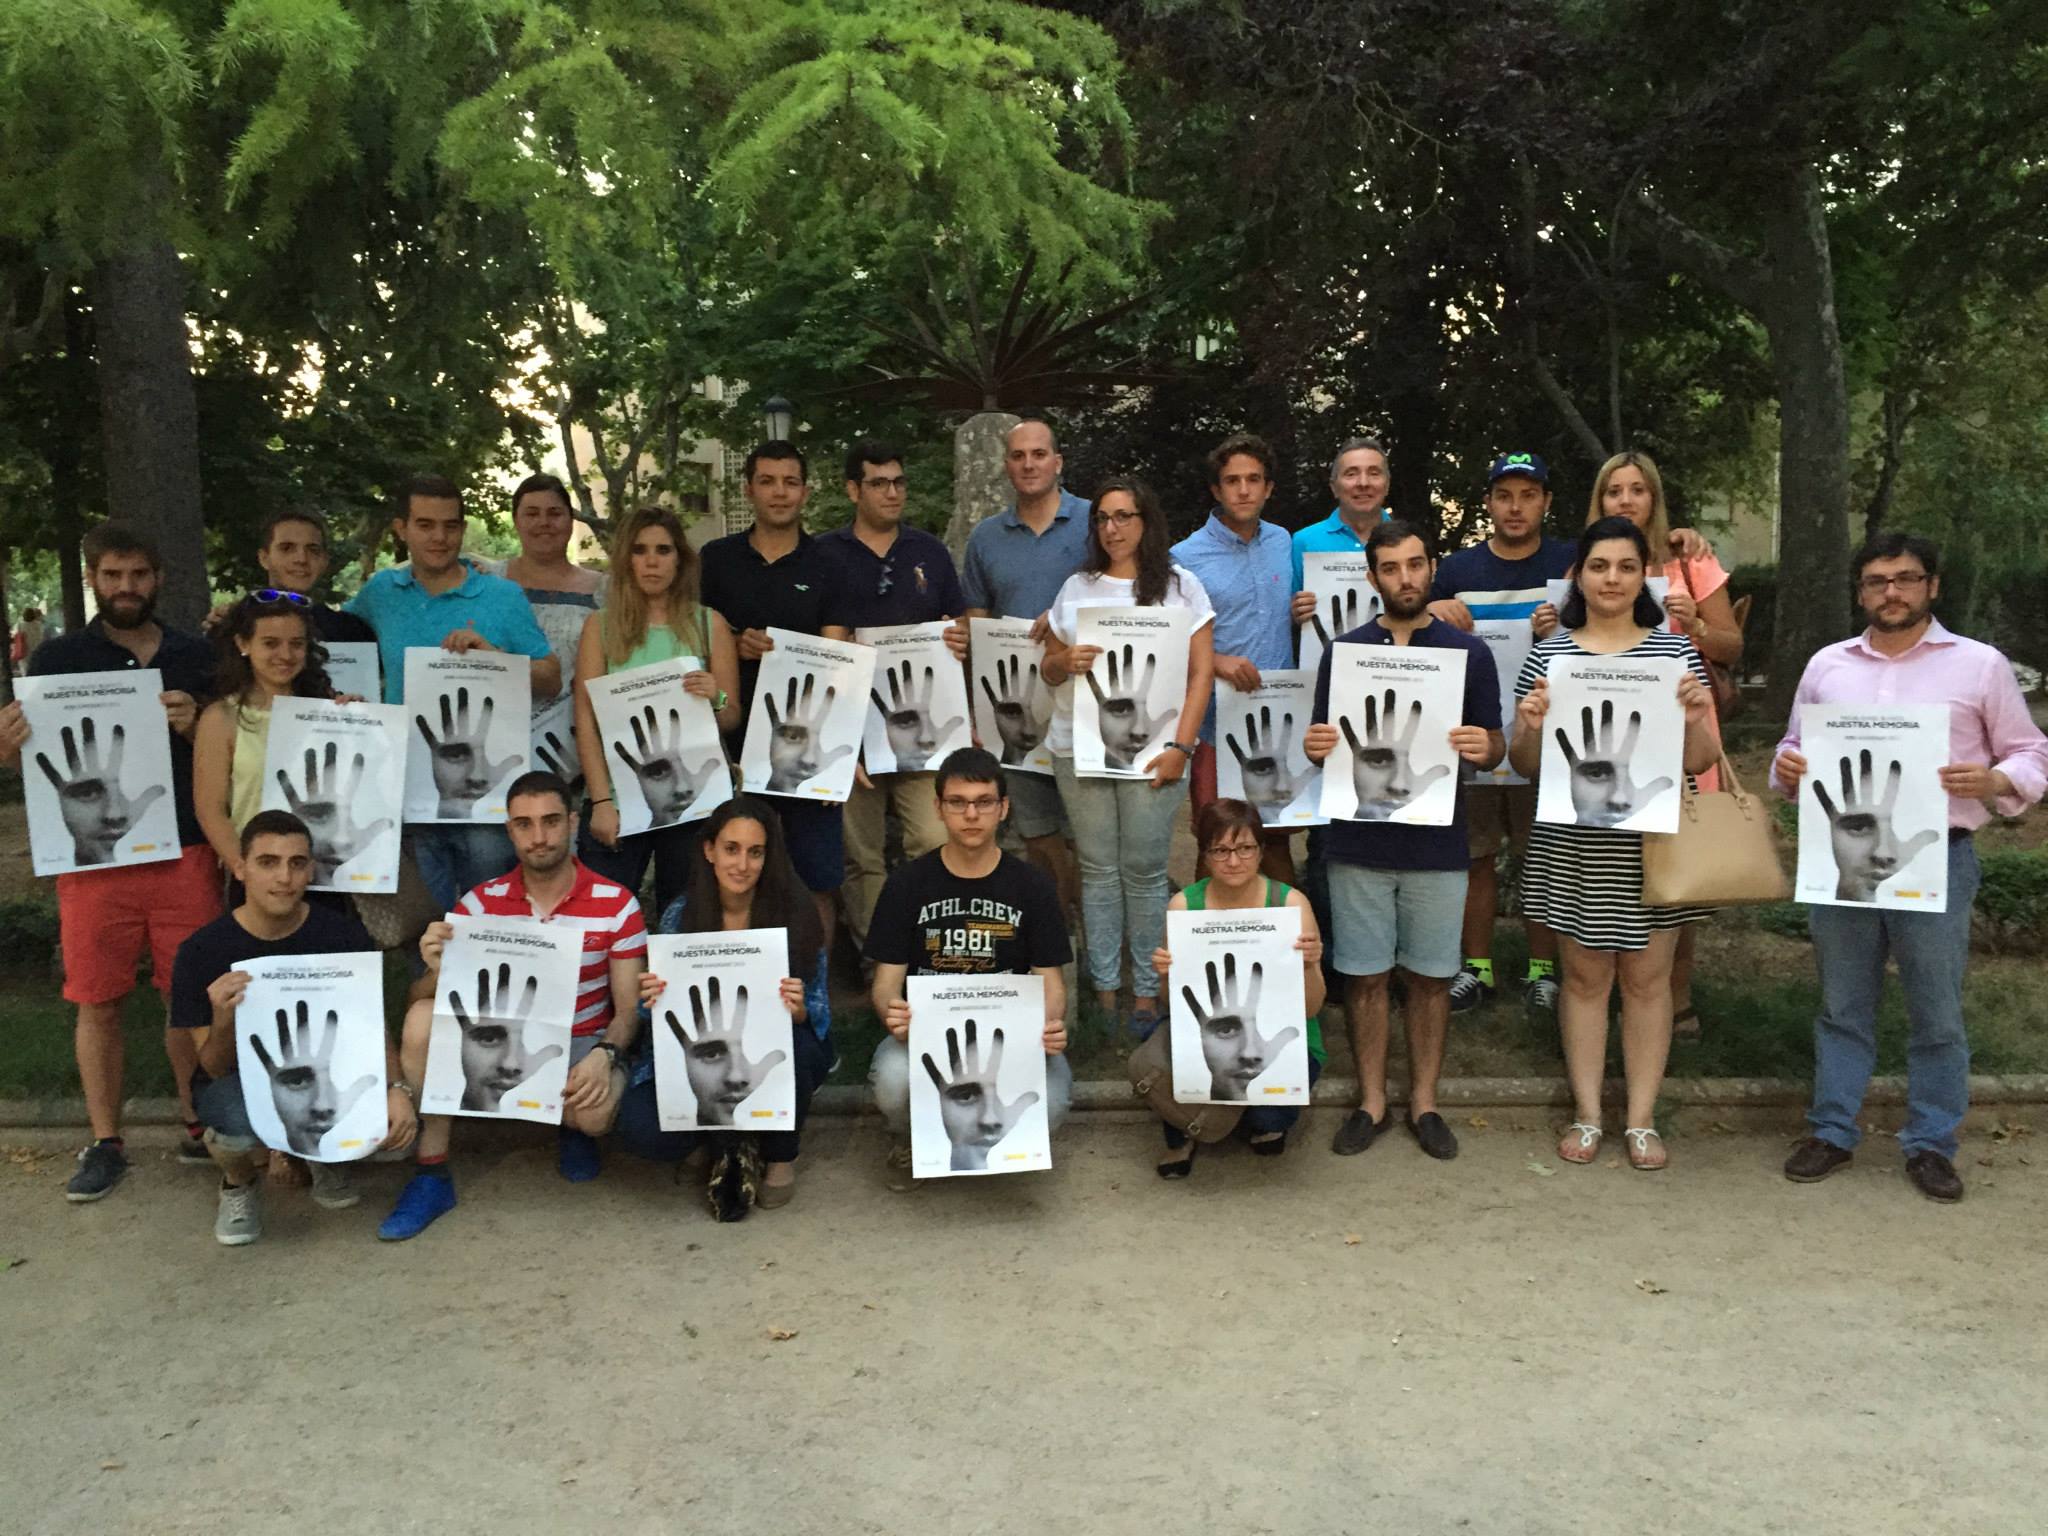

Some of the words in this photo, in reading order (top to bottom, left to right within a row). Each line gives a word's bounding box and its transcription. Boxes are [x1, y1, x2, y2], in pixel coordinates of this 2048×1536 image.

[1323, 565, 1356, 573] NUESTRA
[1098, 620, 1134, 628] NUESTRA
[1135, 620, 1170, 628] MEMORIA
[874, 638, 908, 646] NUESTRA
[909, 635, 941, 644] MEMORIA
[1481, 633, 1511, 641] MORIA
[784, 645, 818, 658] NUESTRA
[820, 651, 854, 665] MEMORIA
[428, 662, 468, 671] NUESTRA
[469, 663, 508, 673] MEMORIA
[1356, 660, 1397, 670] NUESTRA
[1399, 663, 1441, 672] MEMORIA
[1570, 672, 1614, 681] NUESTRA
[1615, 673, 1661, 682] MEMORIA
[609, 682, 645, 696] NUESTRA
[645, 673, 682, 687] MEMORIA
[1269, 682, 1305, 690] MEMORIA
[43, 689, 90, 700] NUESTRA
[91, 686, 137, 697] MEMORIA
[295, 712, 338, 724] NUESTRA
[341, 715, 384, 727] MEMORIA
[1826, 720, 1871, 729] NUESTRA
[1873, 721, 1920, 729] MEMORIA
[917, 898, 1023, 927] ATHL.CREW
[1191, 925, 1233, 934] NUESTRA
[1234, 923, 1276, 932] MEMORIA
[468, 932, 513, 943] NUESTRA
[514, 938, 557, 950] MEMORIA
[943, 928, 993, 952] 1981
[672, 947, 718, 959] NUESTRA
[719, 945, 762, 955] MEMORIA
[261, 971, 306, 981] NUESTRA
[307, 969, 354, 979] MEMORIA
[932, 990, 975, 1000] NUESTRA
[976, 989, 1019, 998] MEMORIA
